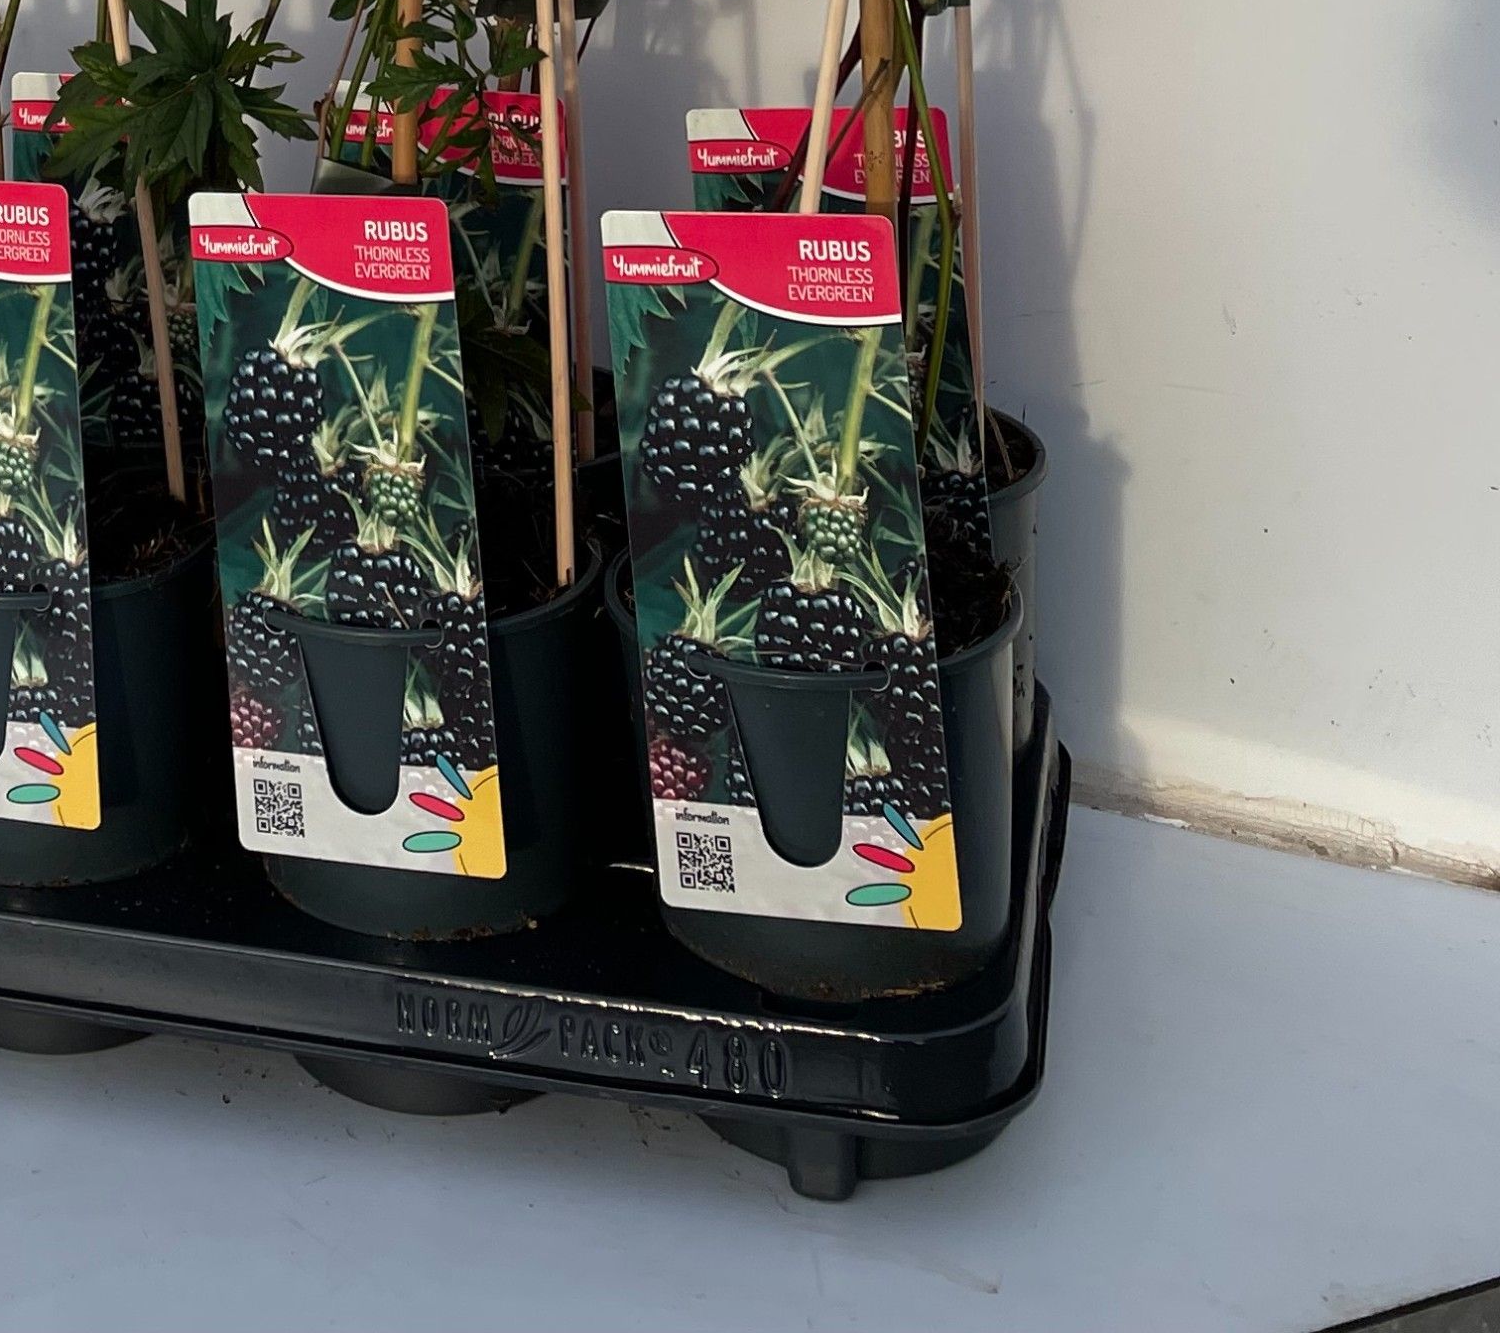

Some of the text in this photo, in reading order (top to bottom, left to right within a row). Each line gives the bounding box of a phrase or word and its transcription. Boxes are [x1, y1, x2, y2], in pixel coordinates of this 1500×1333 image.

[696, 148, 778, 167] Yummiefruit
[364, 220, 428, 243] RUBUS
[199, 234, 280, 256] Yummiefruit
[799, 239, 872, 263] RUBUS
[612, 255, 703, 278] Yummiefruit
[395, 991, 493, 1046] NORM
